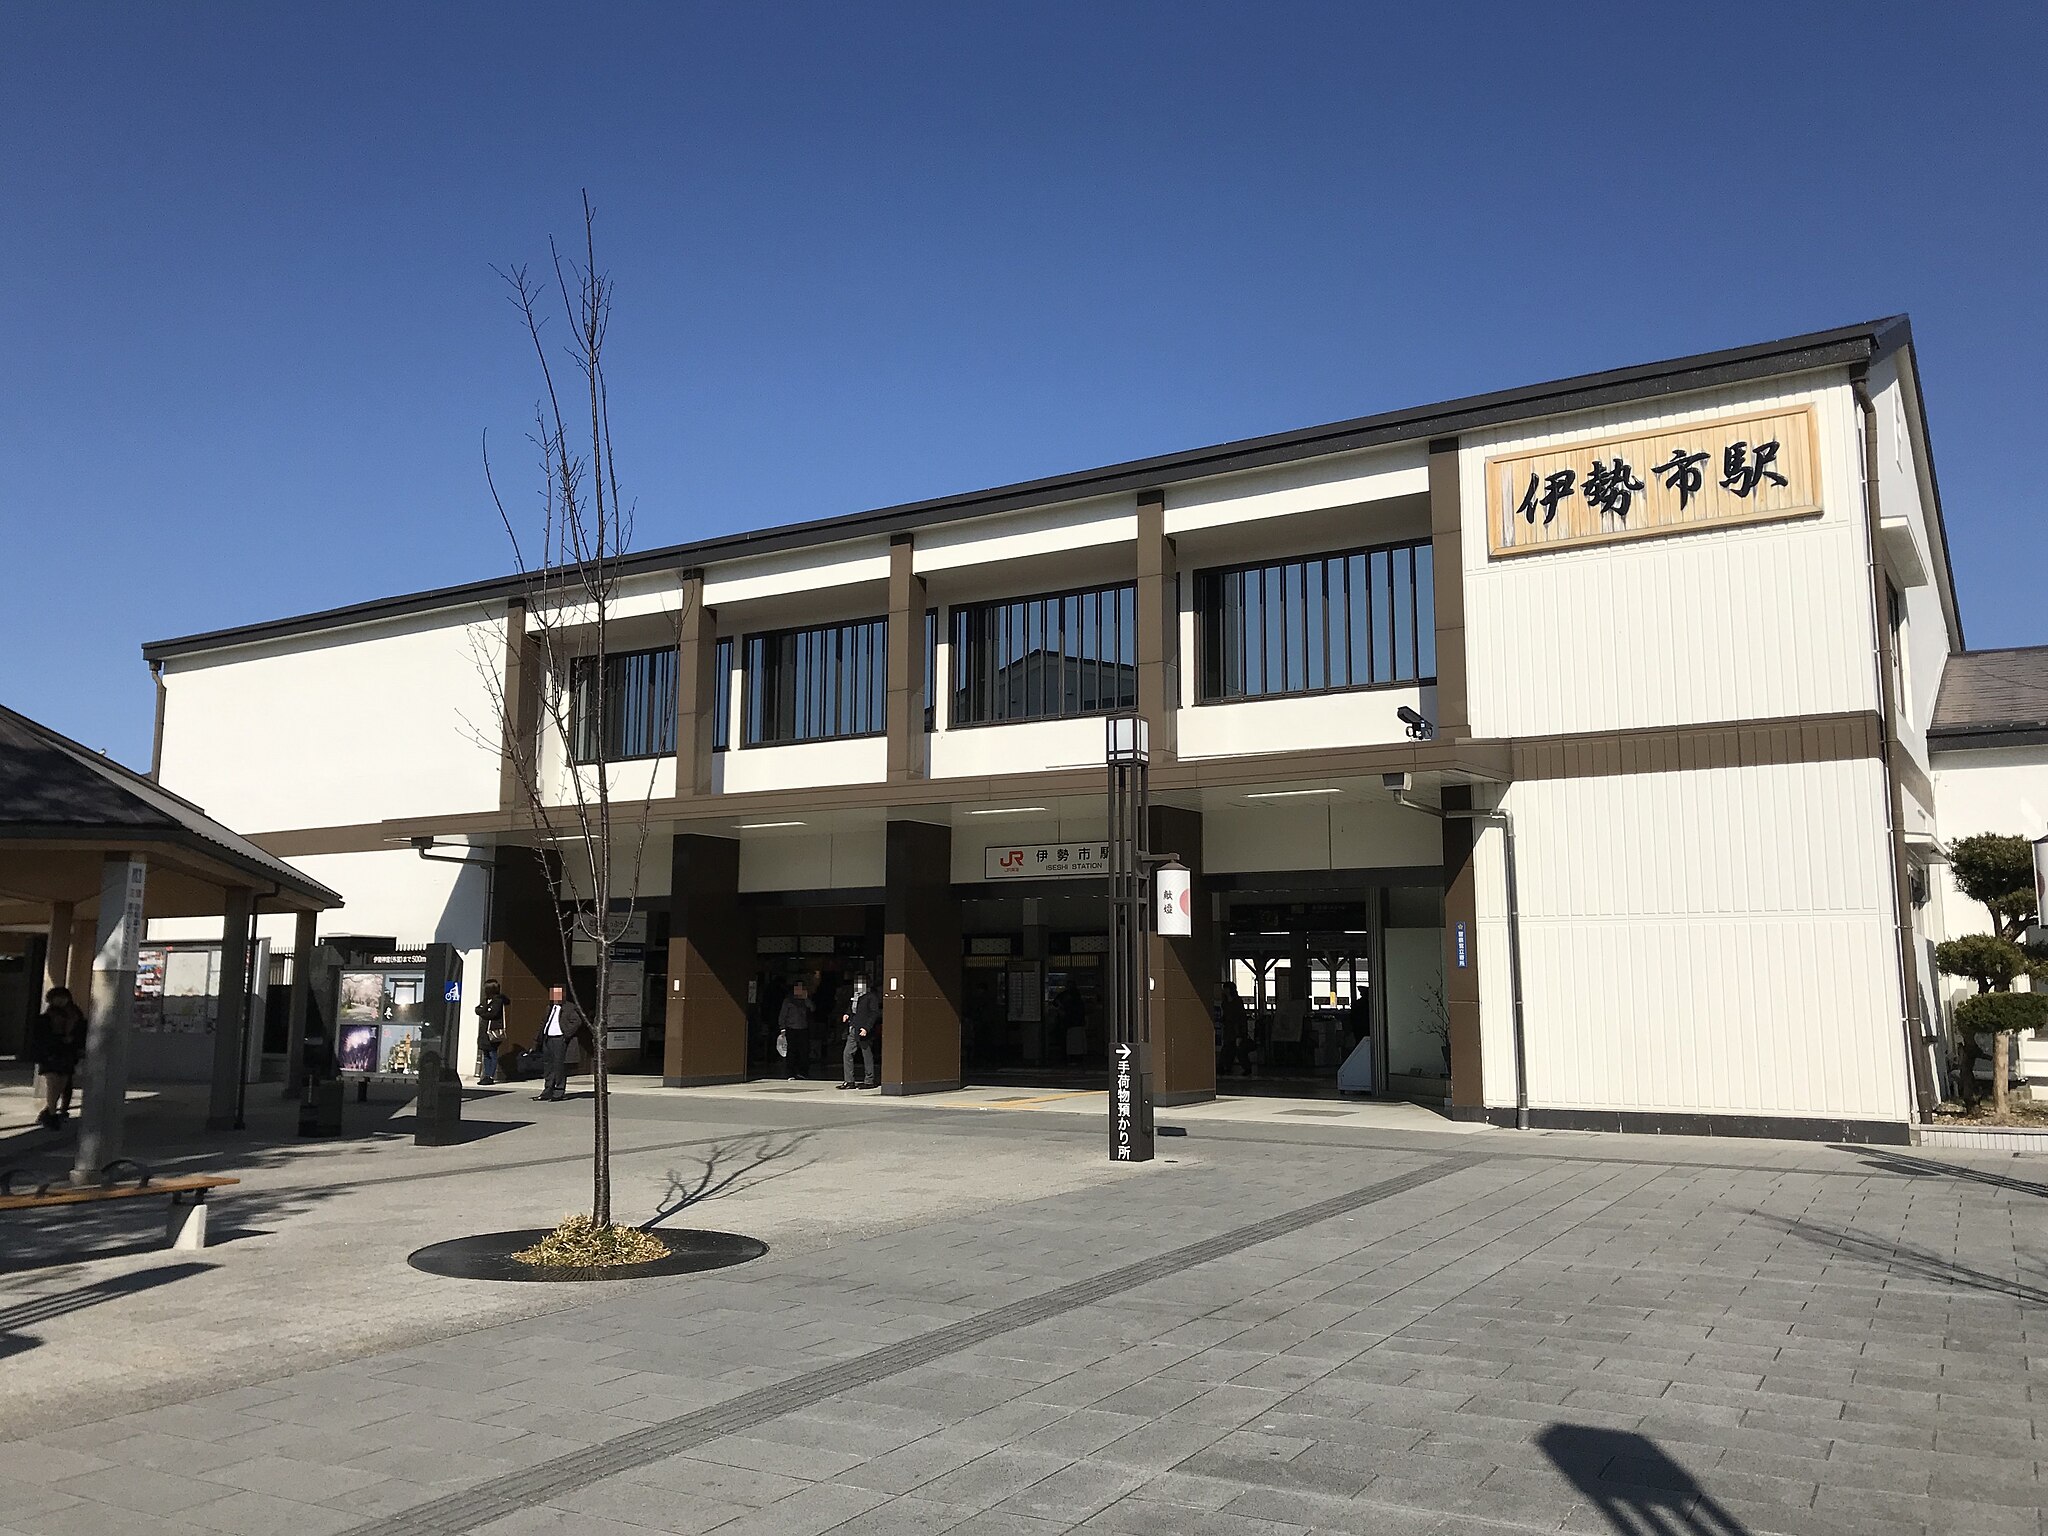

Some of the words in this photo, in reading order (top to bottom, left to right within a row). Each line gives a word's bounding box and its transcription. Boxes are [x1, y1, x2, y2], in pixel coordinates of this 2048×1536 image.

[1516, 441, 1789, 525] 伊勢市駅
[1000, 850, 1024, 867] JR
[1071, 862, 1103, 870] STATION
[1117, 1060, 1131, 1160] 手荷物預かり所
